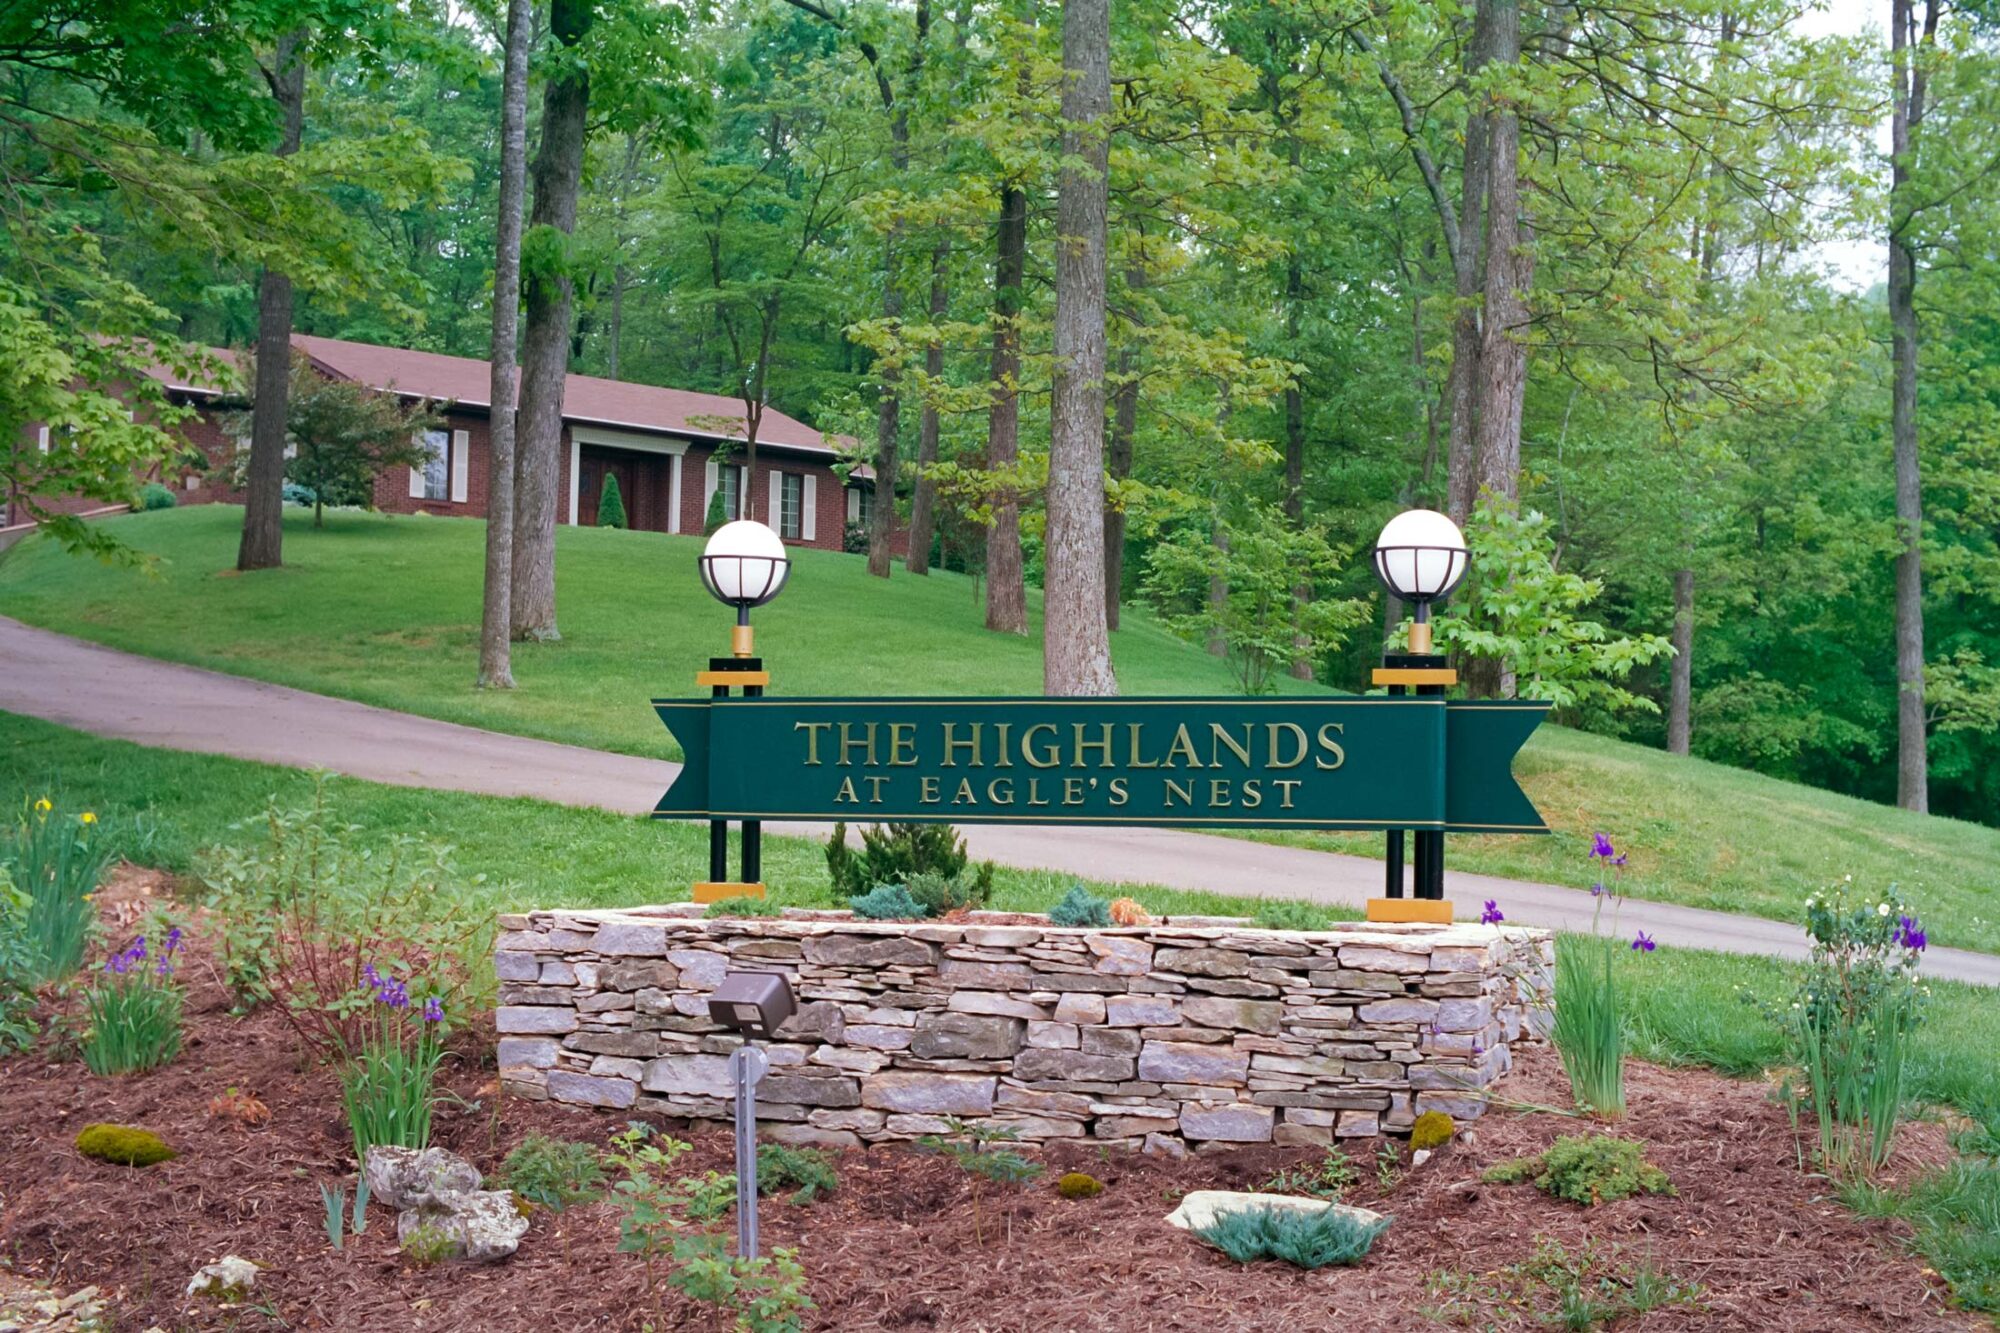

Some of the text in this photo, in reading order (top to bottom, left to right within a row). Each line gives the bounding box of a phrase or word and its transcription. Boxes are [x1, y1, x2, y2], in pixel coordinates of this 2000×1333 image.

[794, 721, 1346, 769] THE HIGHLANDS
[833, 776, 1302, 808] AT EAGLE'S NEST
